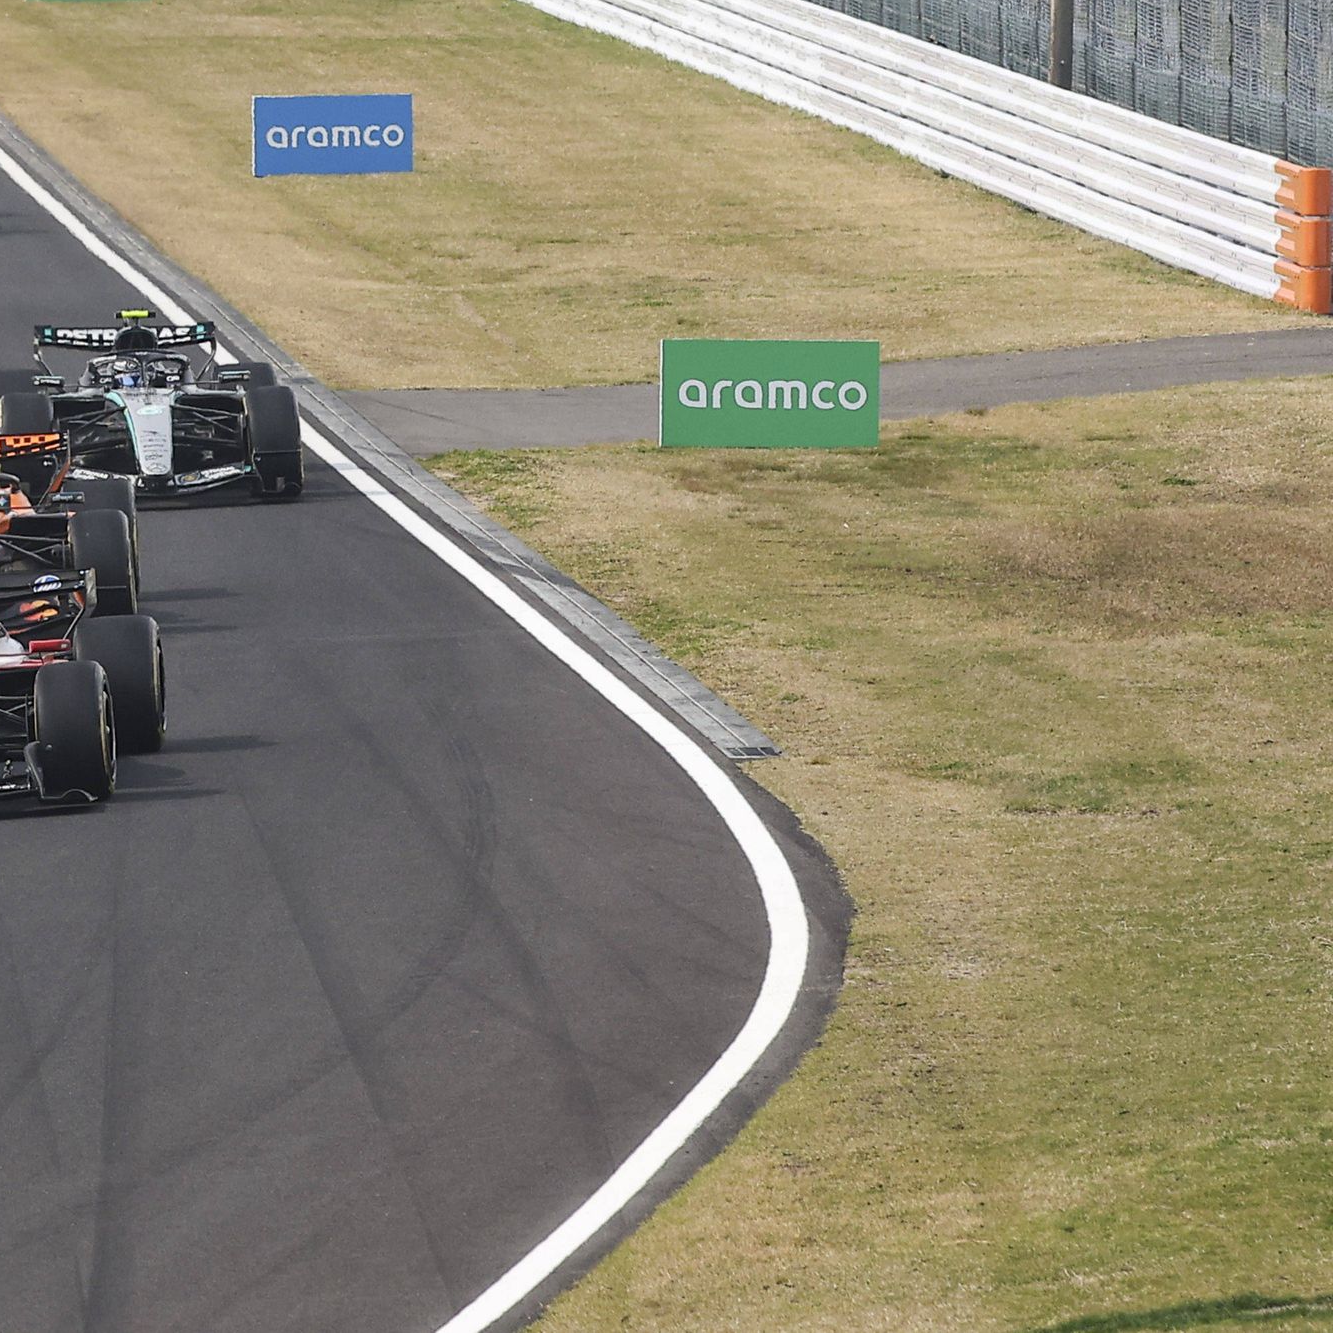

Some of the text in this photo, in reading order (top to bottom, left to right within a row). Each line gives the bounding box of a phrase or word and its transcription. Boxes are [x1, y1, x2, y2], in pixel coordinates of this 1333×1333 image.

[266, 124, 404, 149] aramco
[56, 328, 191, 346] PETRAS
[679, 379, 867, 411] aramco
